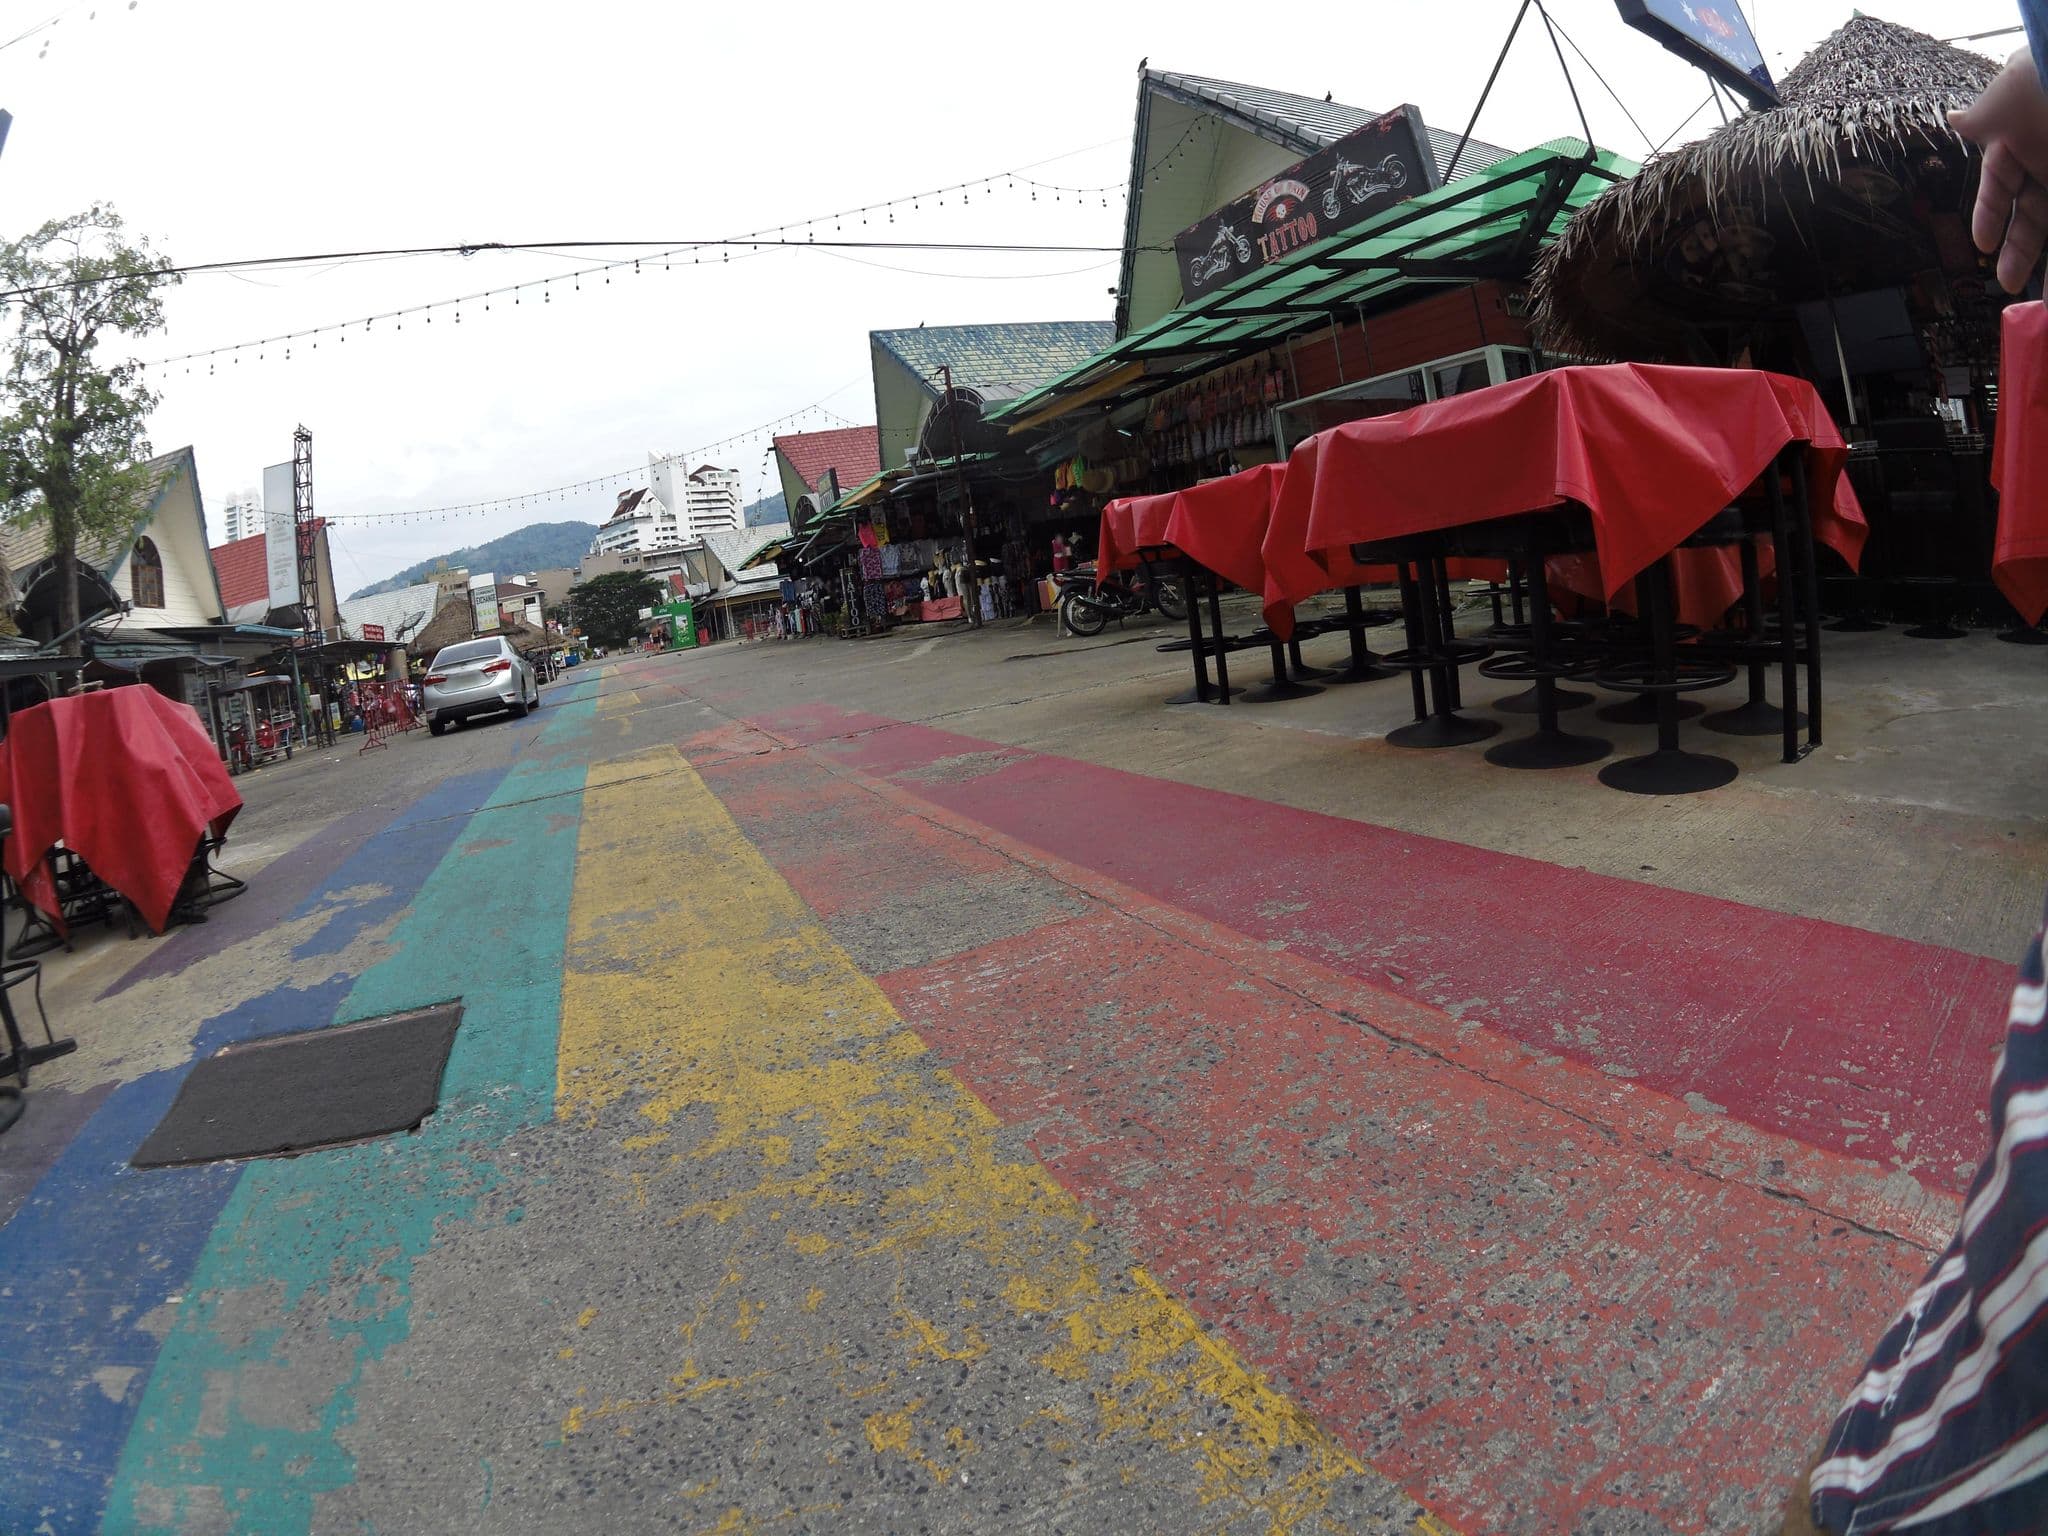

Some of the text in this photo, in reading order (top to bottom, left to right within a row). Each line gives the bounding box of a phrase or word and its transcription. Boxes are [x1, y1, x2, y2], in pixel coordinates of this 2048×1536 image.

[1257, 212, 1317, 261] TATTOO
[476, 593, 496, 604] EXCHANGE
[848, 572, 860, 625] TATTOO
